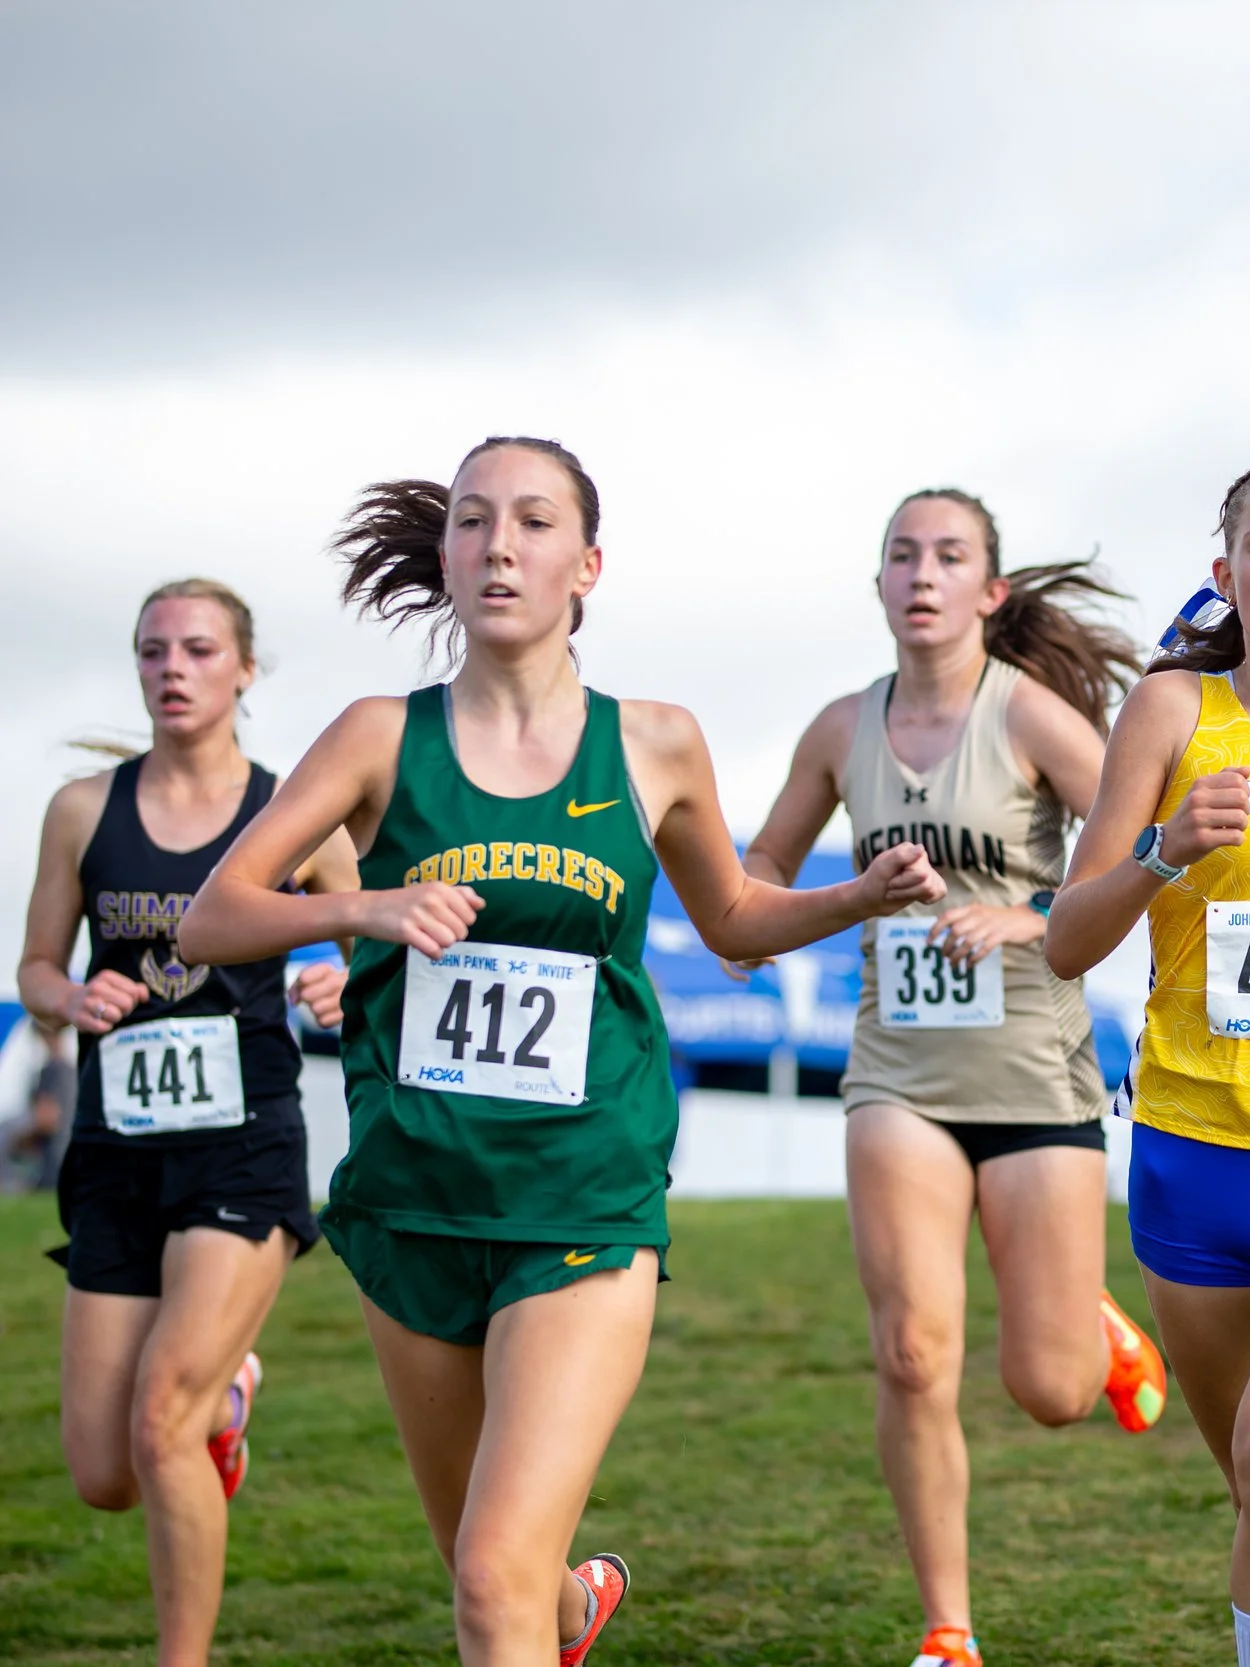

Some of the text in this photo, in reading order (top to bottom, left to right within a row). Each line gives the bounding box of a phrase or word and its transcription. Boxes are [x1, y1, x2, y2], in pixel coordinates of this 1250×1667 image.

[464, 954, 498, 972] PAYNE
[538, 963, 574, 980] INVITE
[895, 944, 977, 1005] 339
[436, 978, 556, 1070] 412
[127, 1045, 213, 1108] 441
[418, 1065, 464, 1084] HOKA
